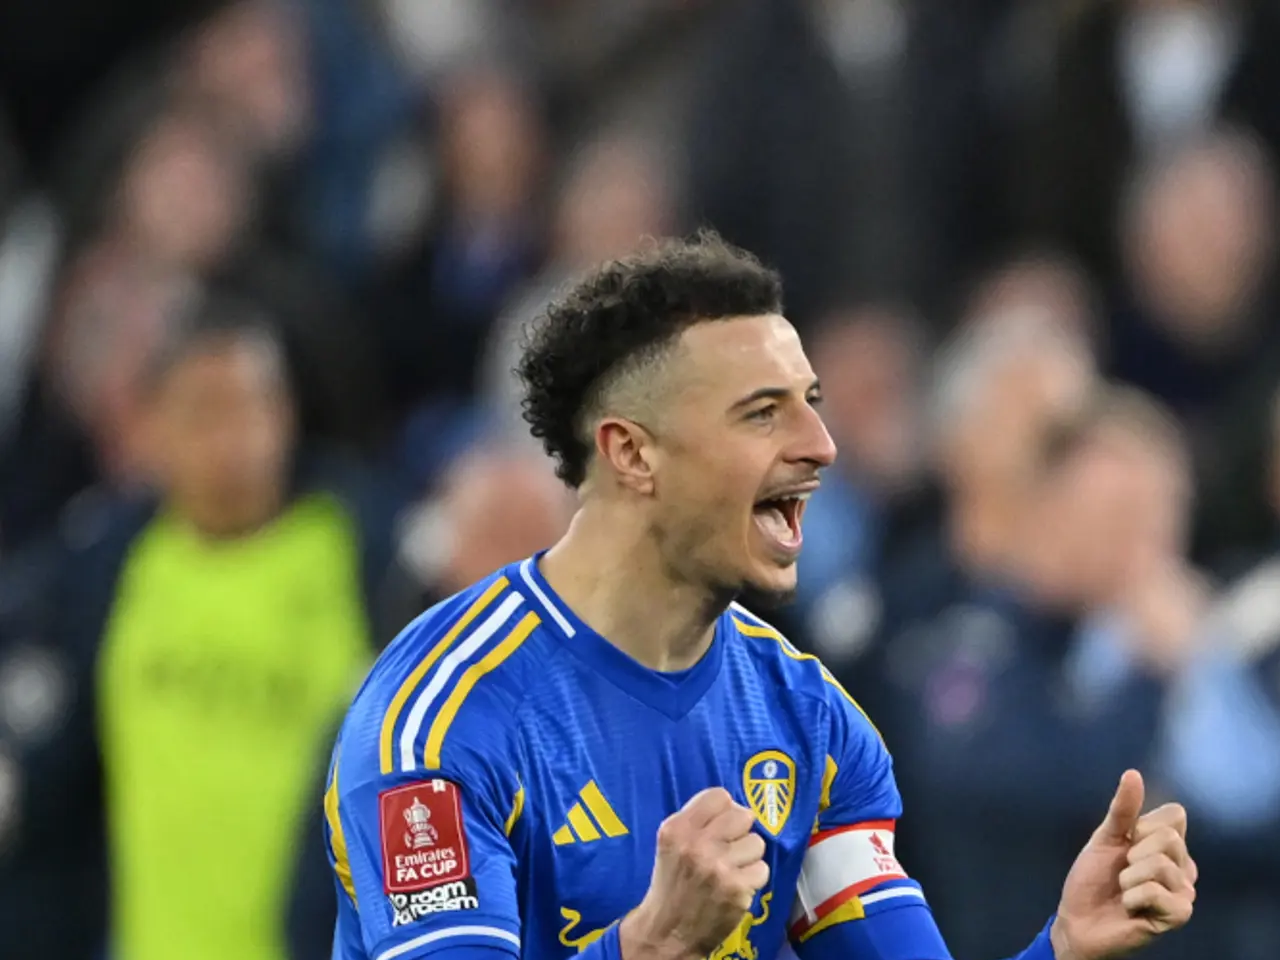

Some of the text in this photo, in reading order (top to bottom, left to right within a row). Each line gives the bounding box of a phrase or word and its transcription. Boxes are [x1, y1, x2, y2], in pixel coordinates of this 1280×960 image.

[395, 847, 456, 868] Emirates
[396, 859, 457, 882] FA CUP
[410, 881, 467, 904] room
[410, 896, 479, 918] racism
